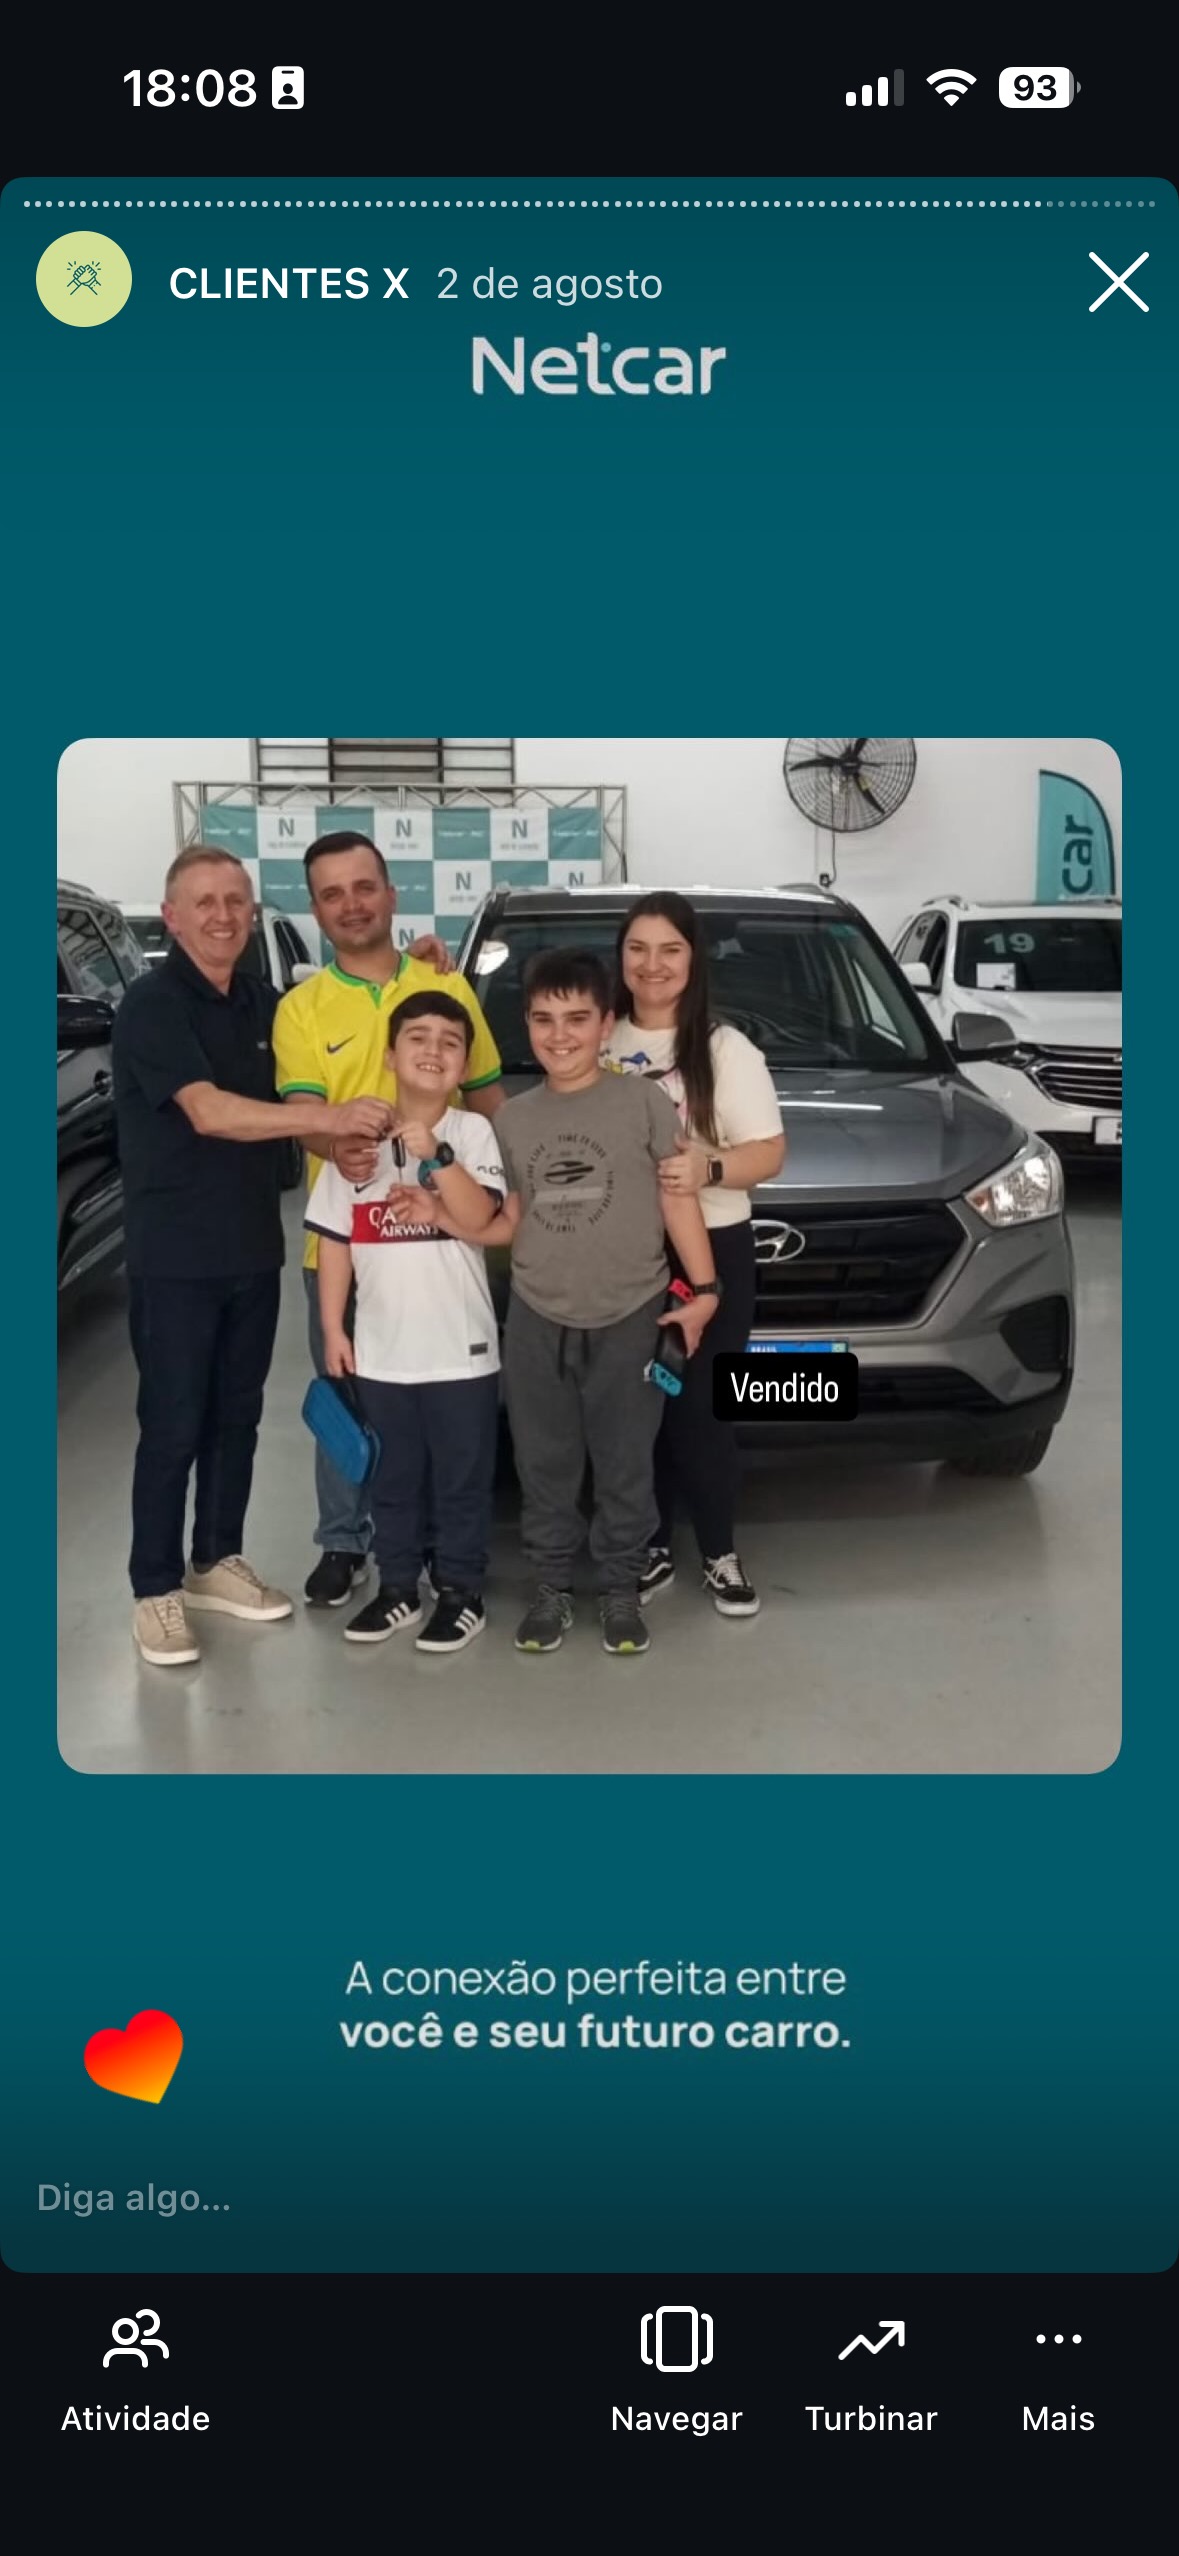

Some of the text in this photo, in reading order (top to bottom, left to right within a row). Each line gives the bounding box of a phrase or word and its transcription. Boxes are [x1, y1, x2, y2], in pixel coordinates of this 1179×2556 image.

[278, 818, 295, 837] N
[396, 819, 412, 838] N
[512, 819, 528, 839] N
[455, 871, 472, 890] N
[983, 932, 1035, 954] 19
